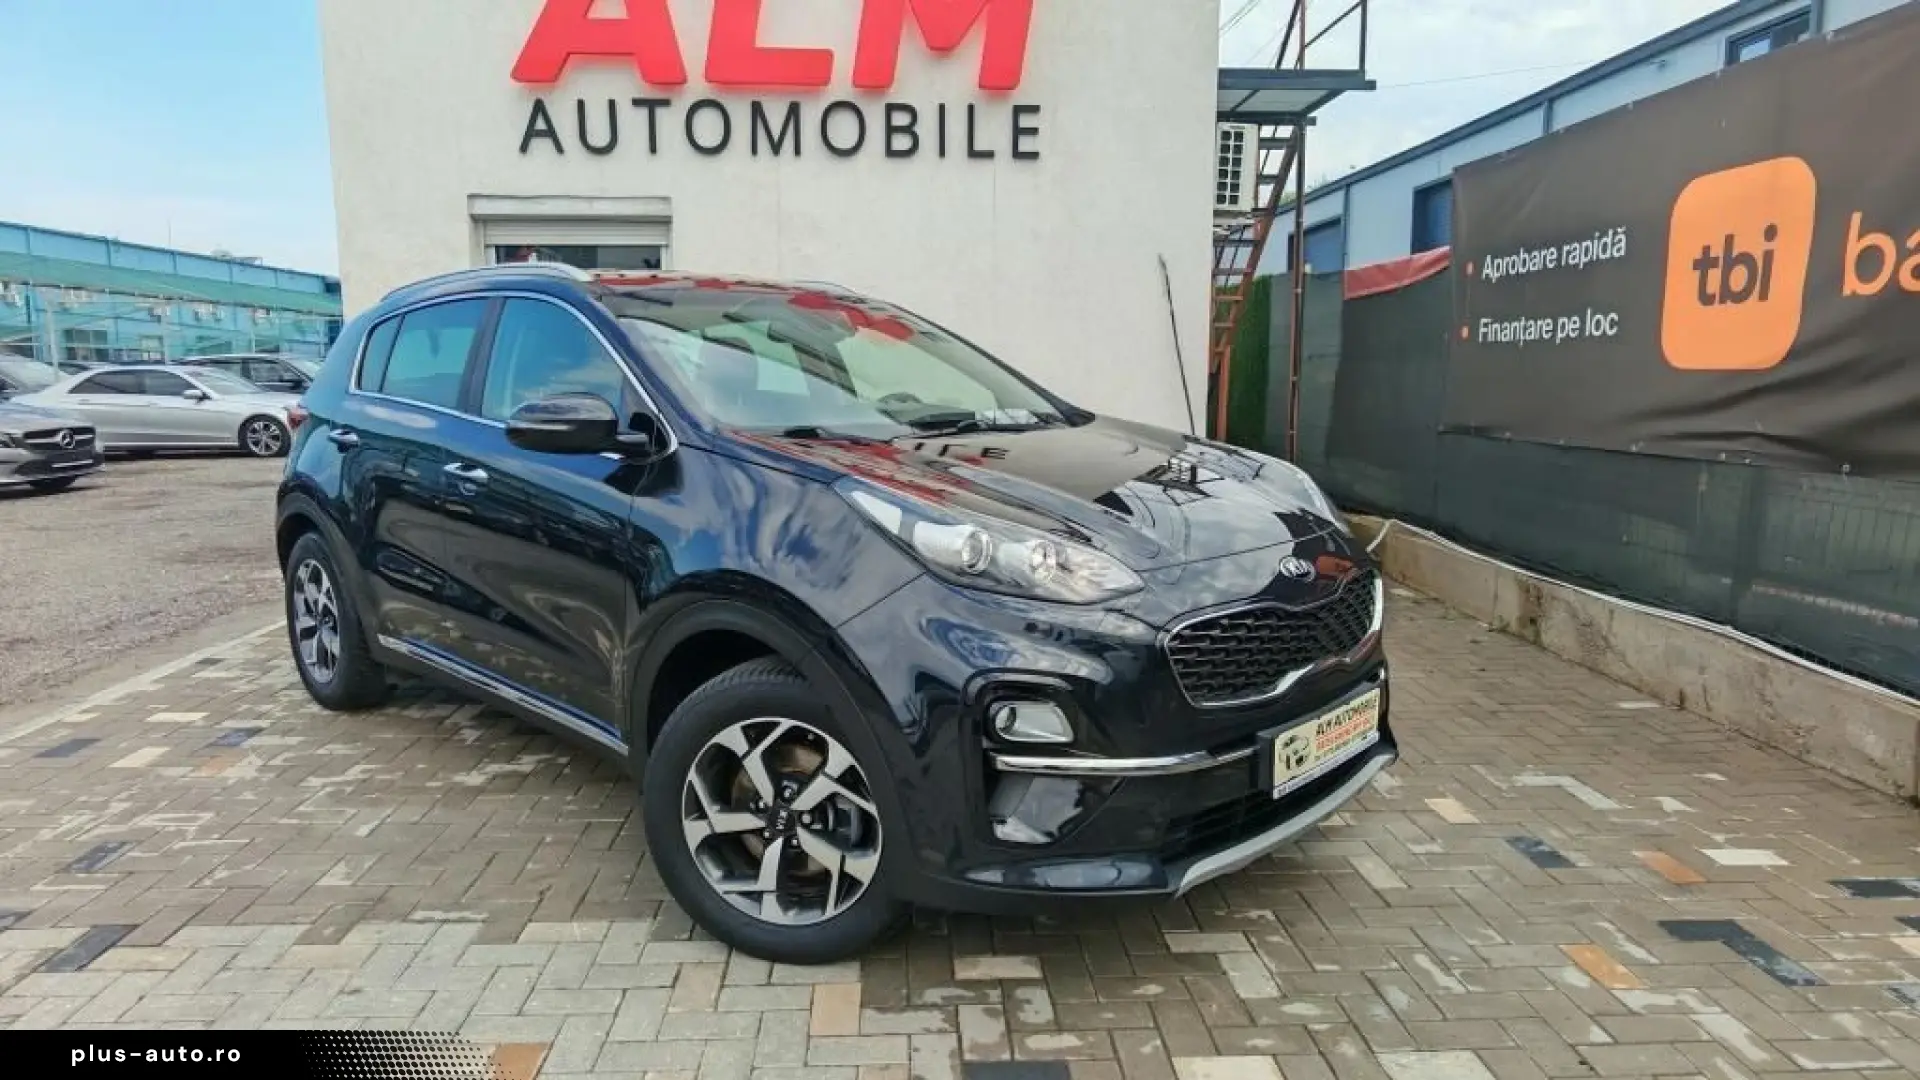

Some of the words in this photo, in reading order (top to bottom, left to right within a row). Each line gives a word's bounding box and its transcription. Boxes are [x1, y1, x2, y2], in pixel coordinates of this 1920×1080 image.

[510, 0, 1034, 91] ALM
[518, 98, 1041, 160] AUTOMOBILE
[1481, 246, 1558, 283] Aprobare
[1561, 224, 1627, 270] rapidă
[1693, 222, 1778, 307] tbi
[1556, 316, 1580, 345] pe
[1585, 307, 1619, 337] loc
